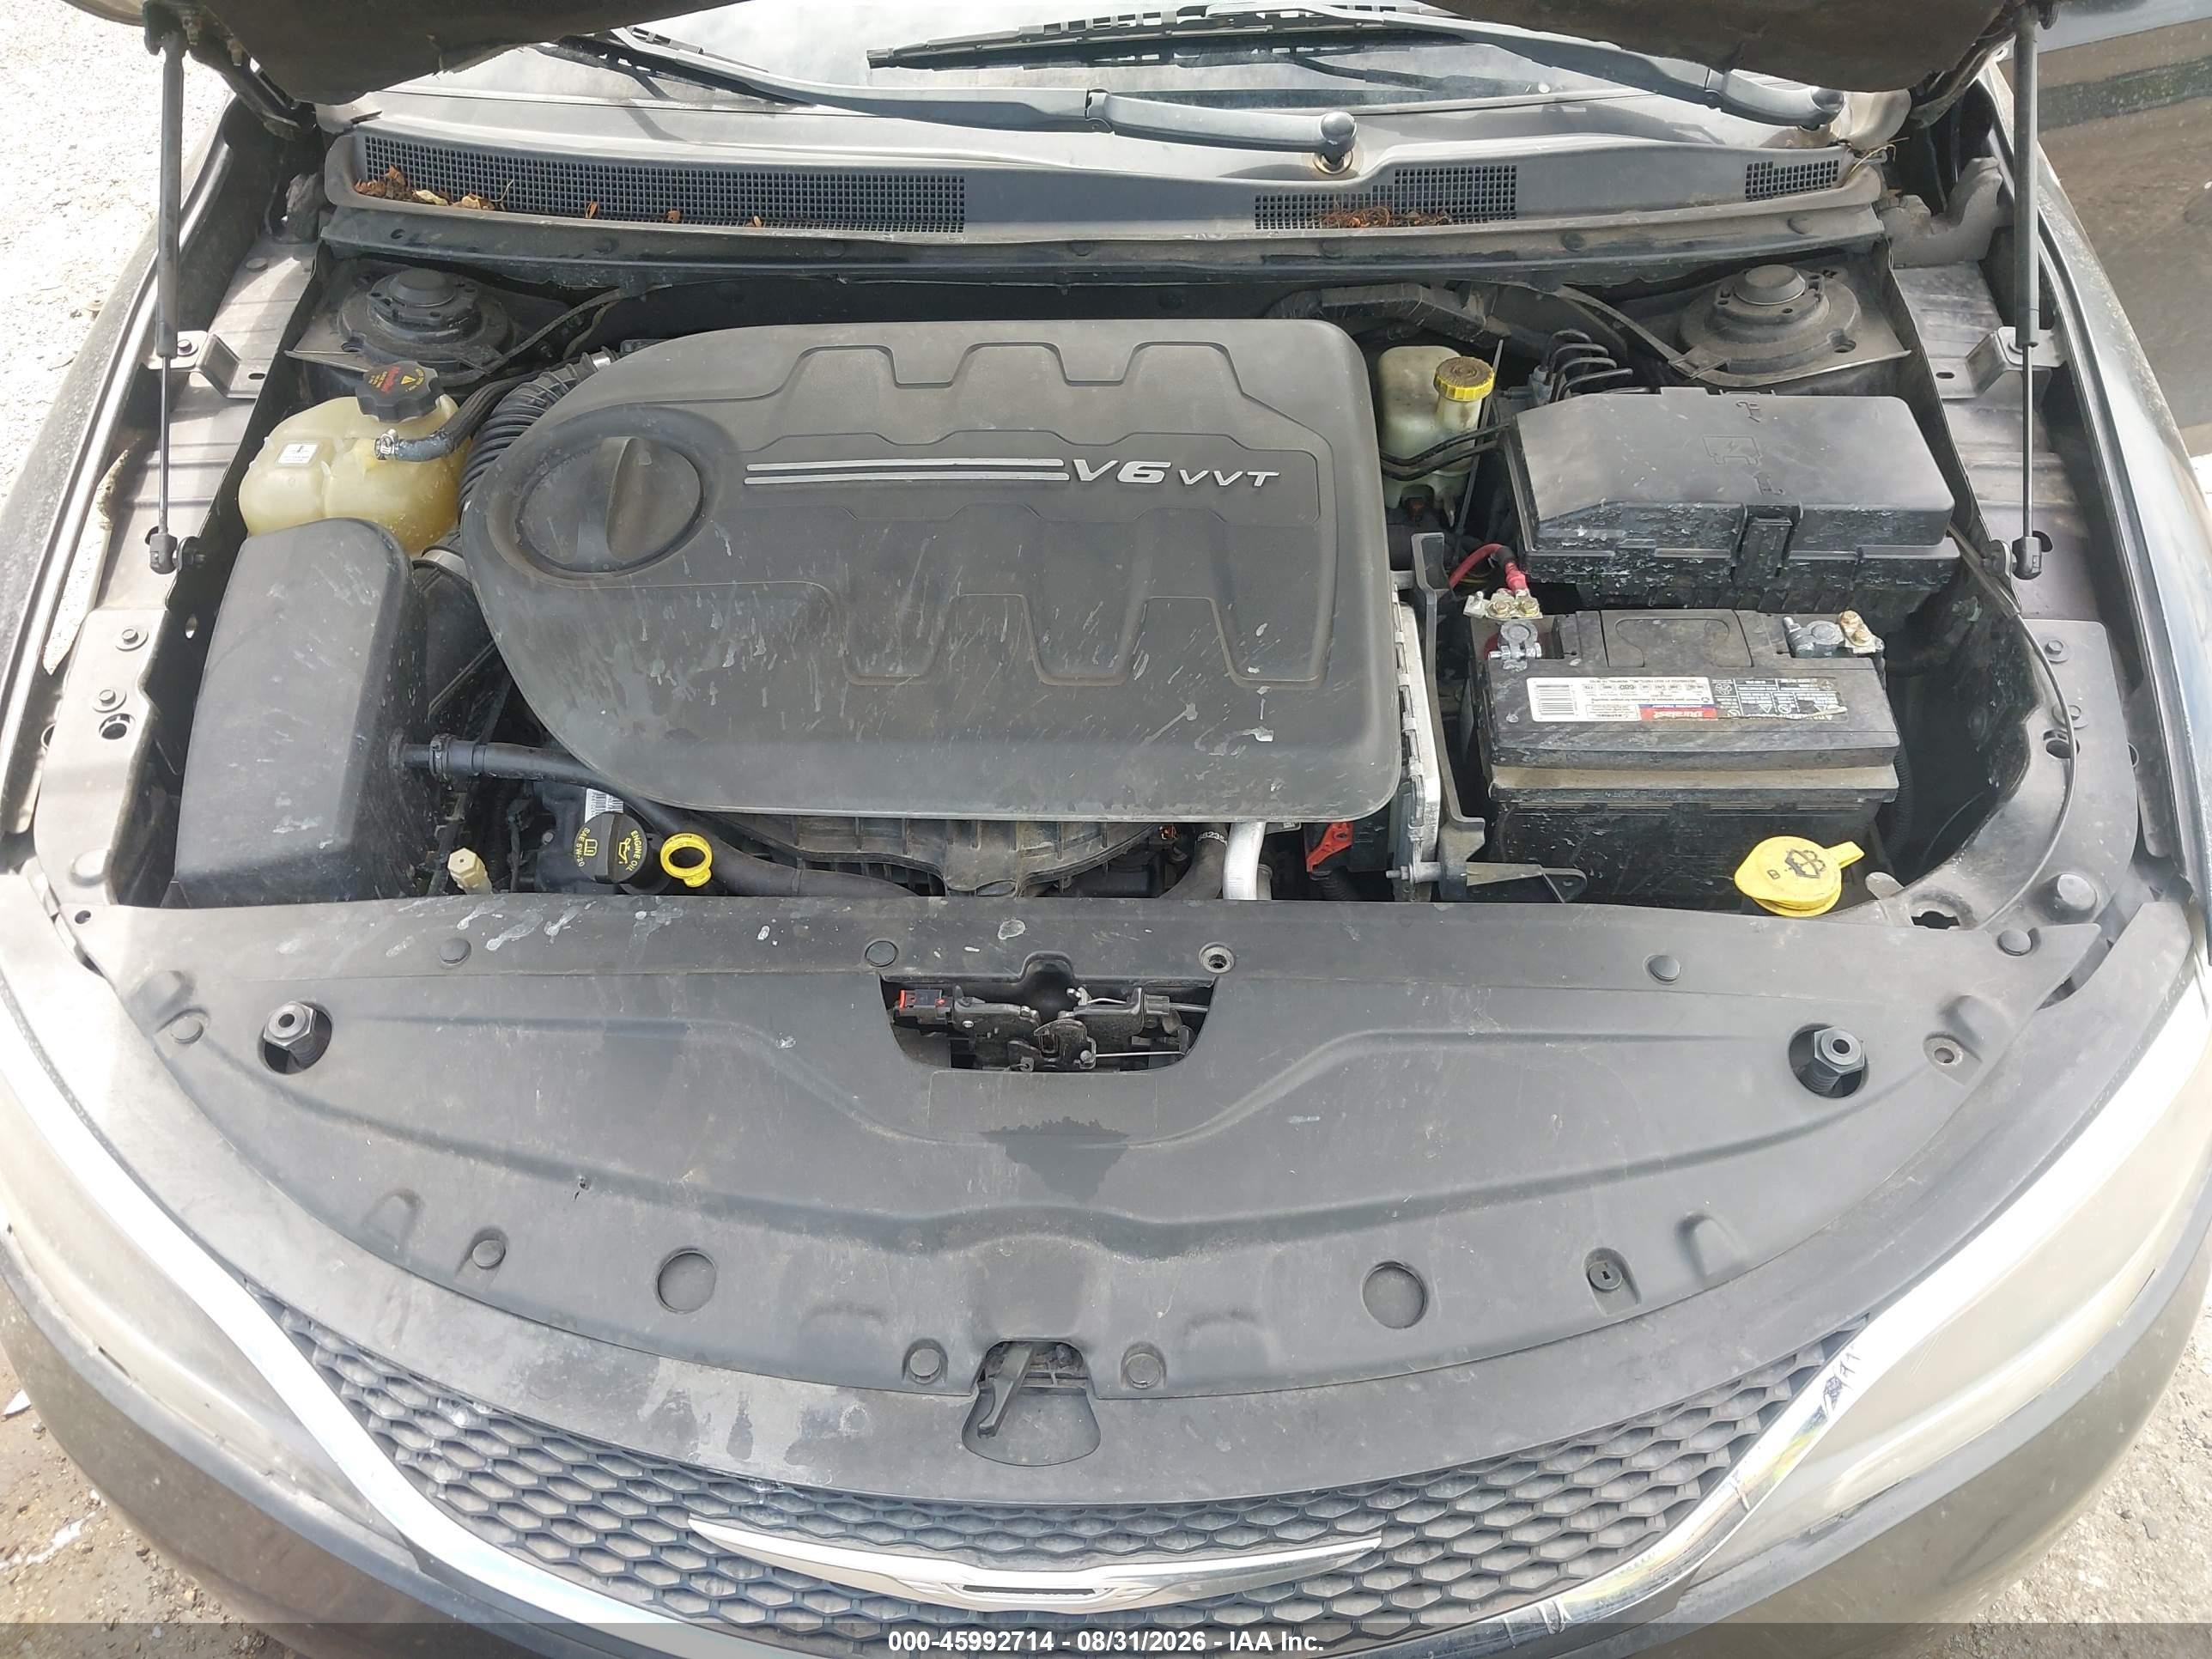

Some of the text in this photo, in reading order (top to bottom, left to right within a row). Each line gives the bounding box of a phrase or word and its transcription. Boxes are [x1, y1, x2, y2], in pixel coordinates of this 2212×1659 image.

[1073, 459, 1280, 488] V6 VVT
[575, 827, 591, 867] SAE 5W-20
[625, 830, 642, 872] ENGINE OIL
